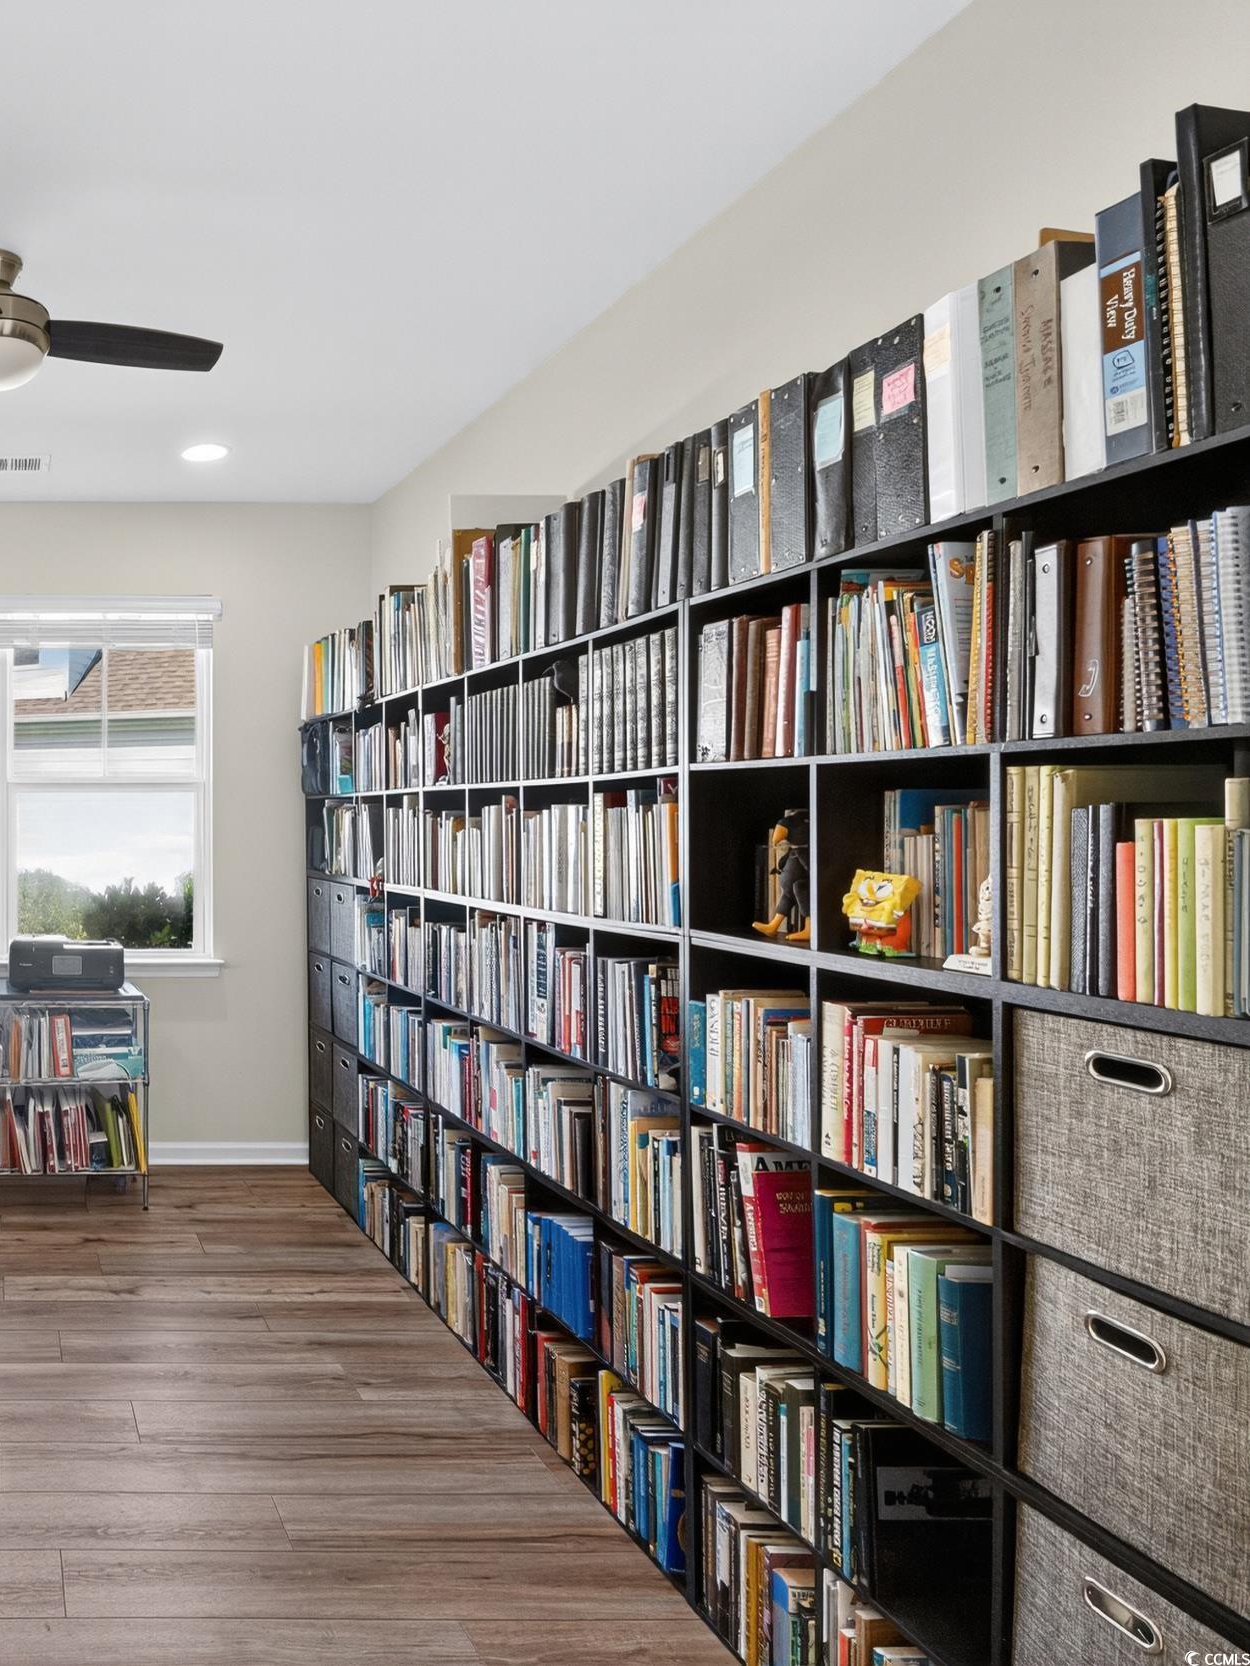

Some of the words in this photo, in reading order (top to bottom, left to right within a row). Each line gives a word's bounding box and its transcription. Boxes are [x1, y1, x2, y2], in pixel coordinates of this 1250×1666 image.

[1120, 267, 1136, 308] Heavy
[1106, 293, 1119, 328] View
[1122, 306, 1137, 341] Duty
